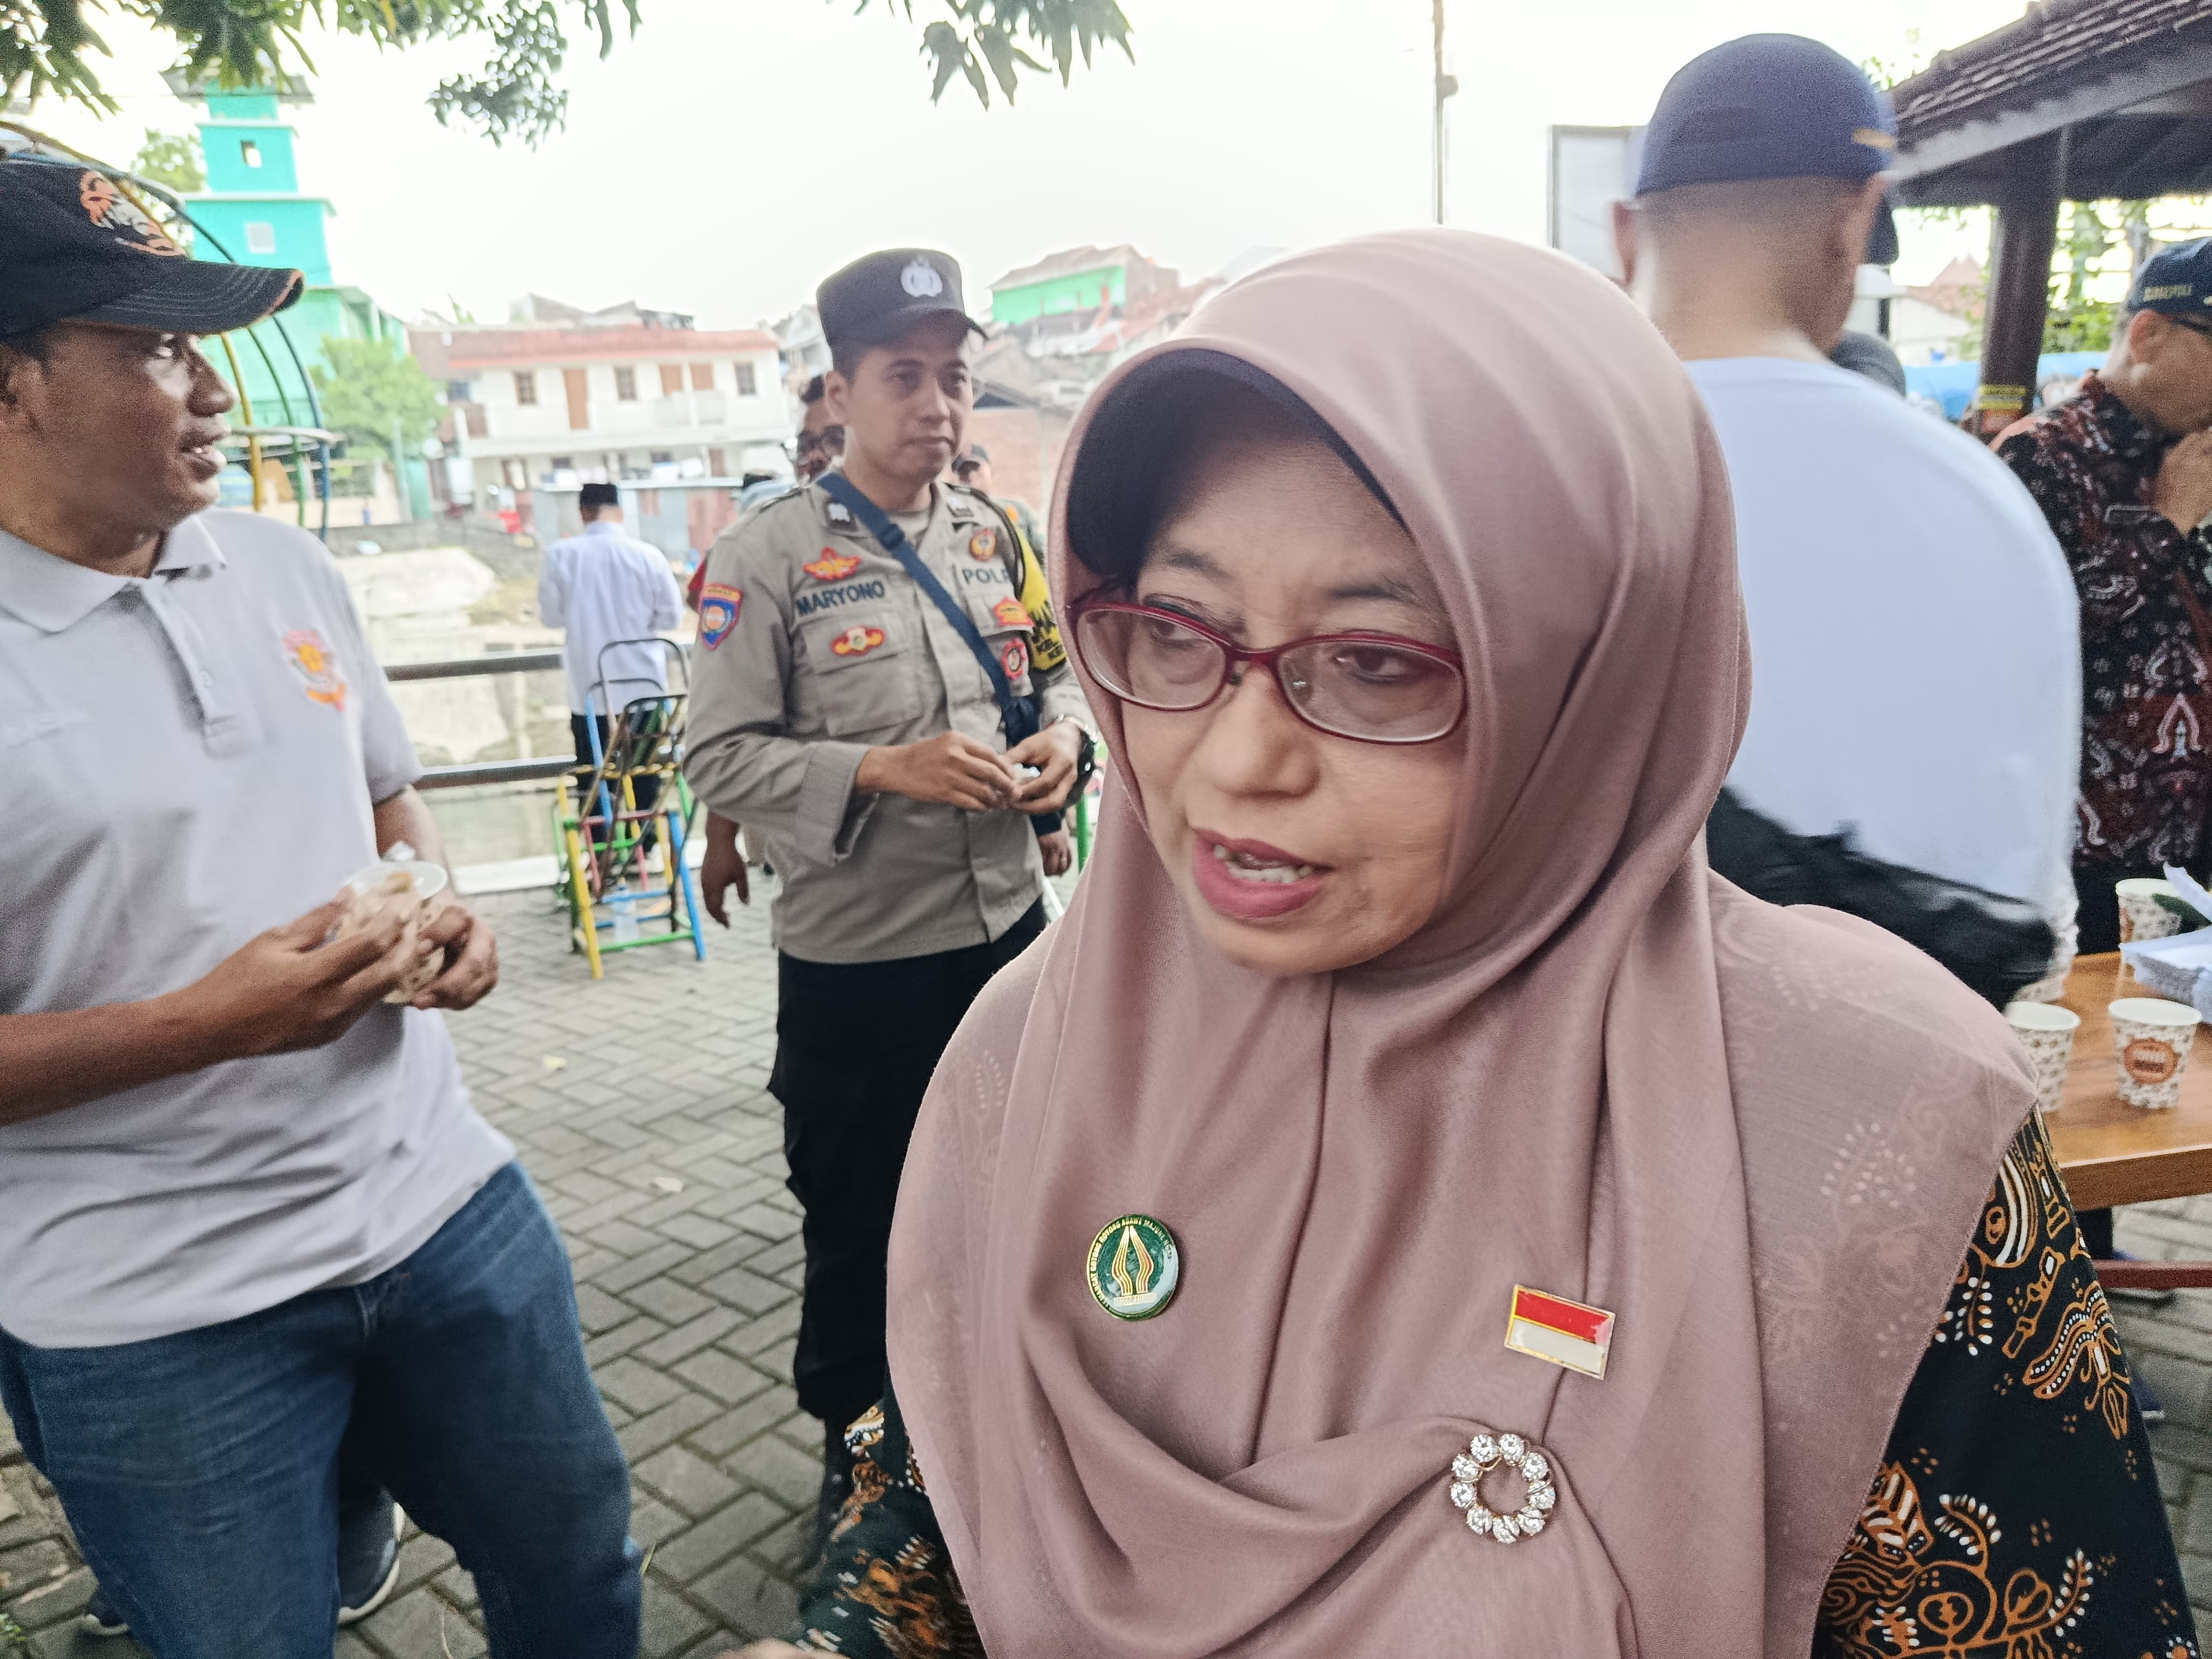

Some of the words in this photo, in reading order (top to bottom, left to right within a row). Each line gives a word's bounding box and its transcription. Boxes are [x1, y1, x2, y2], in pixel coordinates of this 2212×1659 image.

[796, 581, 885, 617] MARYONO
[1090, 1242, 1102, 1271] GOTONG
[1099, 1221, 1121, 1243] ROYONG
